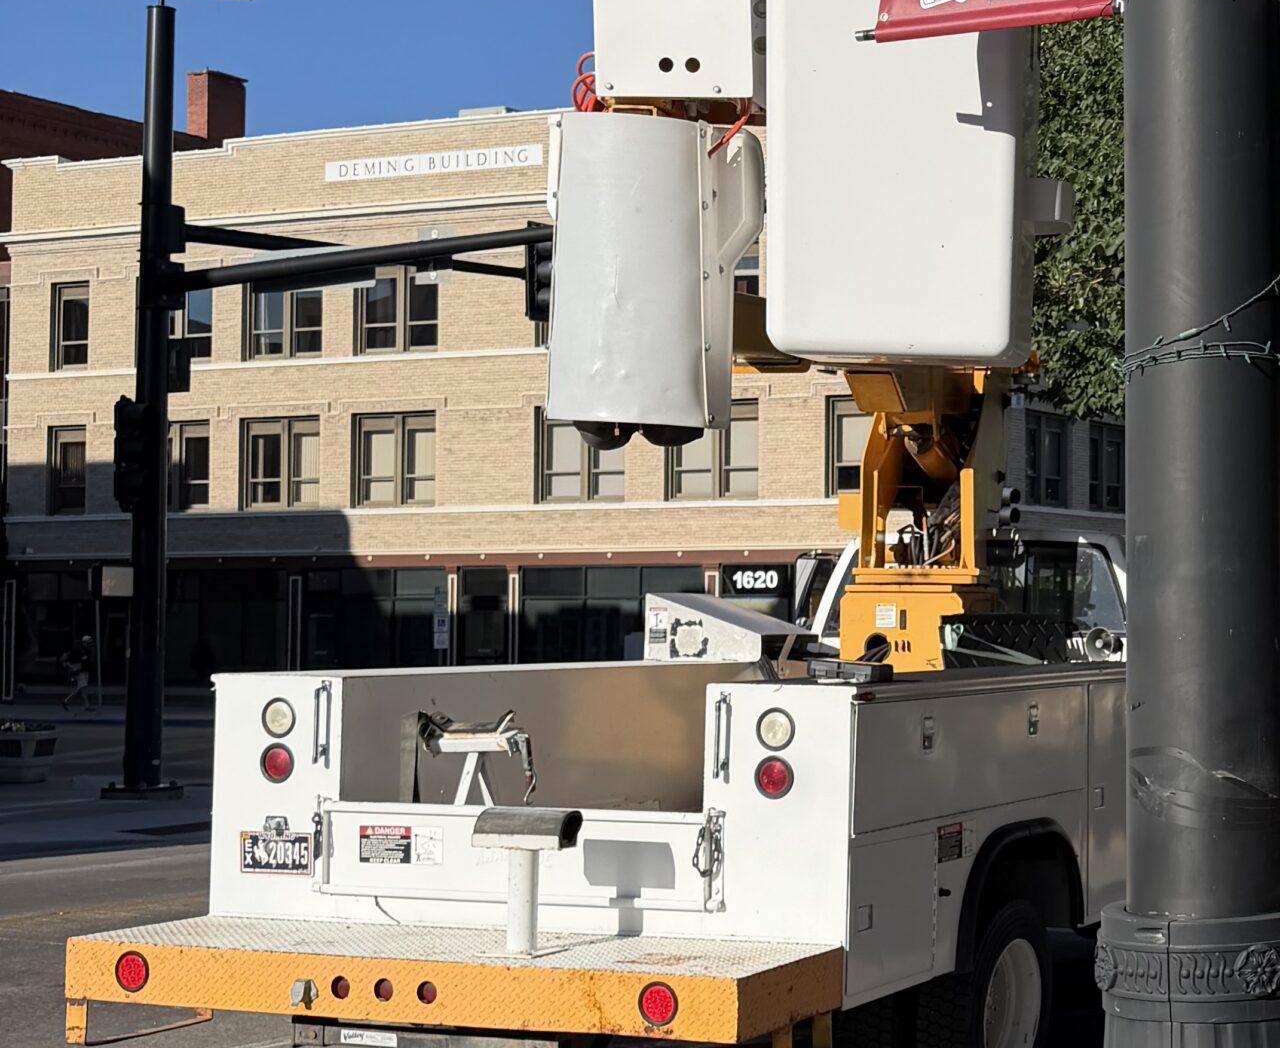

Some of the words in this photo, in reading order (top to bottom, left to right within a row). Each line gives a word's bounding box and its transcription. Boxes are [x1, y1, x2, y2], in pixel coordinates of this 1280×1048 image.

[339, 159, 415, 178] DEMING
[428, 148, 529, 171] BUILDING
[733, 570, 778, 589] 1620
[374, 827, 406, 835] DANGER
[269, 841, 308, 865] 20345
